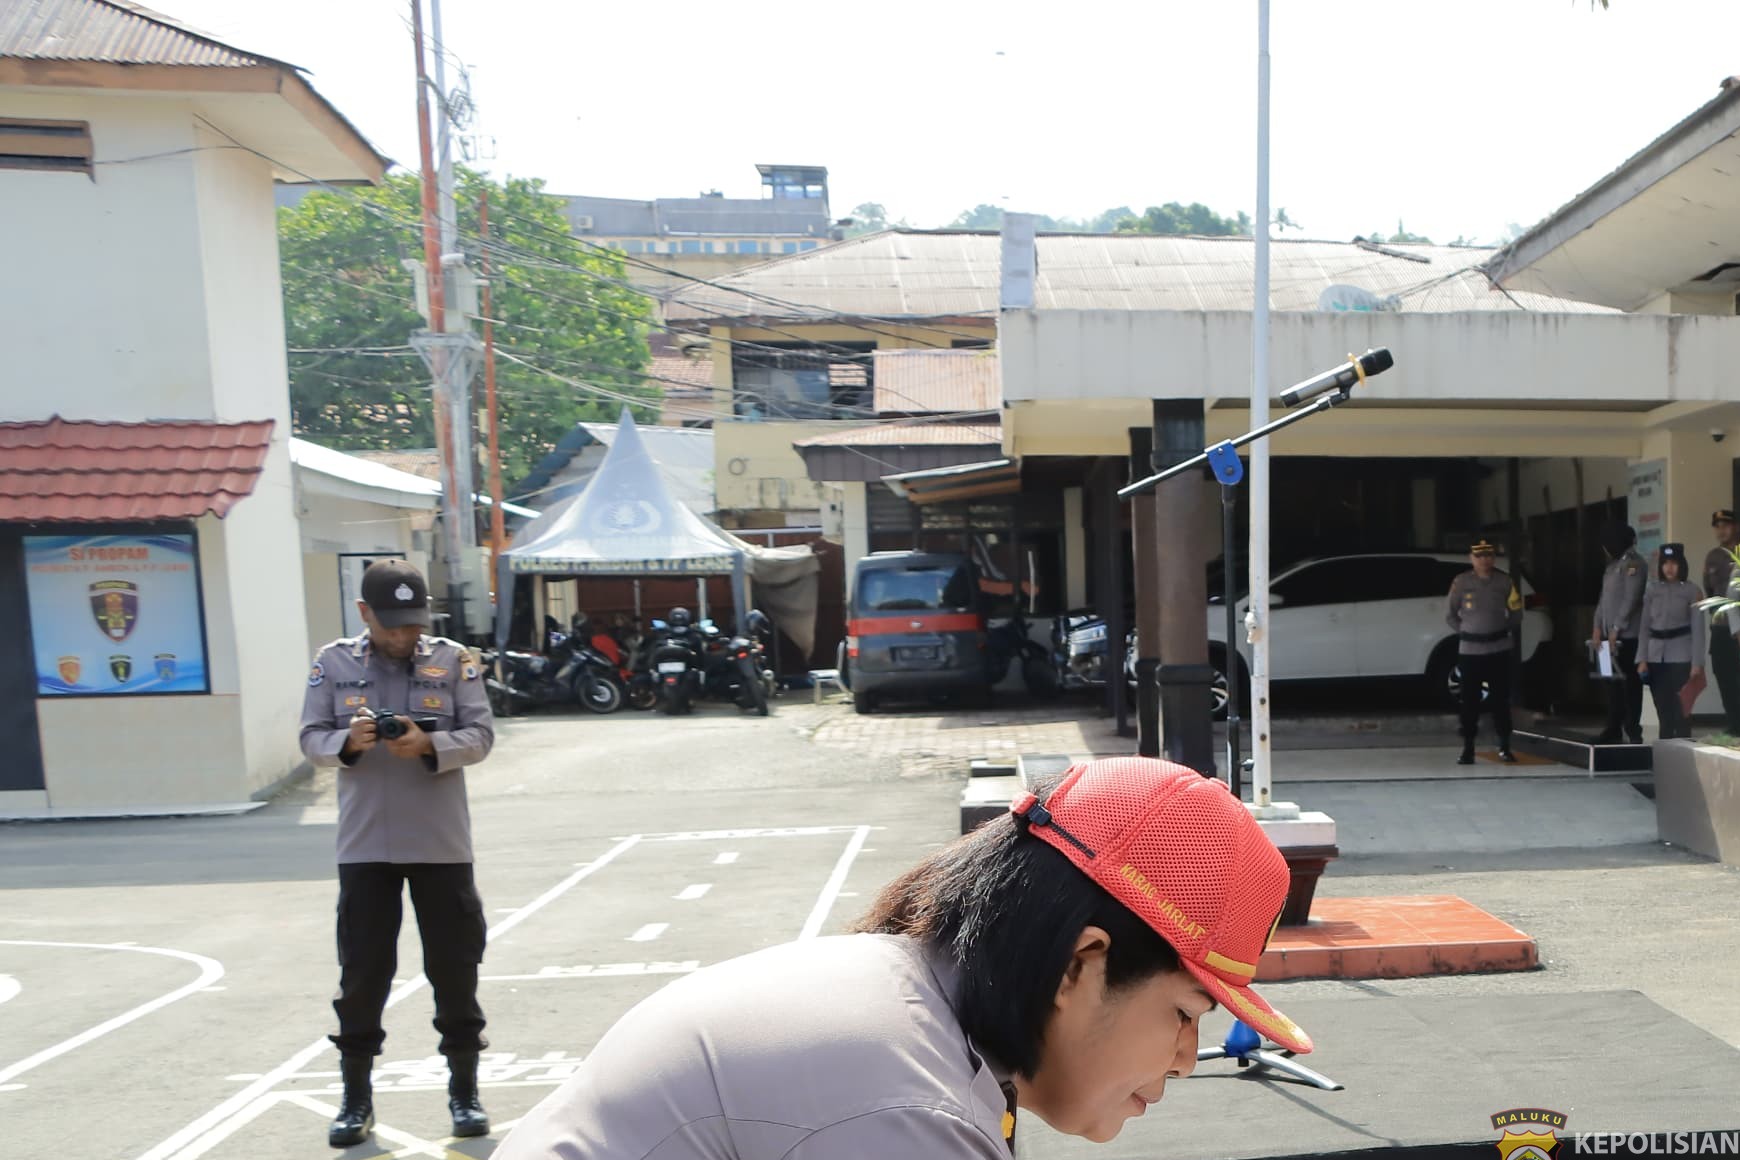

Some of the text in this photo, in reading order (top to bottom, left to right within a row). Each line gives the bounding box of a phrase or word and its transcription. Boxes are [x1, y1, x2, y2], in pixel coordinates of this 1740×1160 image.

[88, 546, 149, 560] PROPAM
[1120, 863, 1206, 940] KABAG JARLAT
